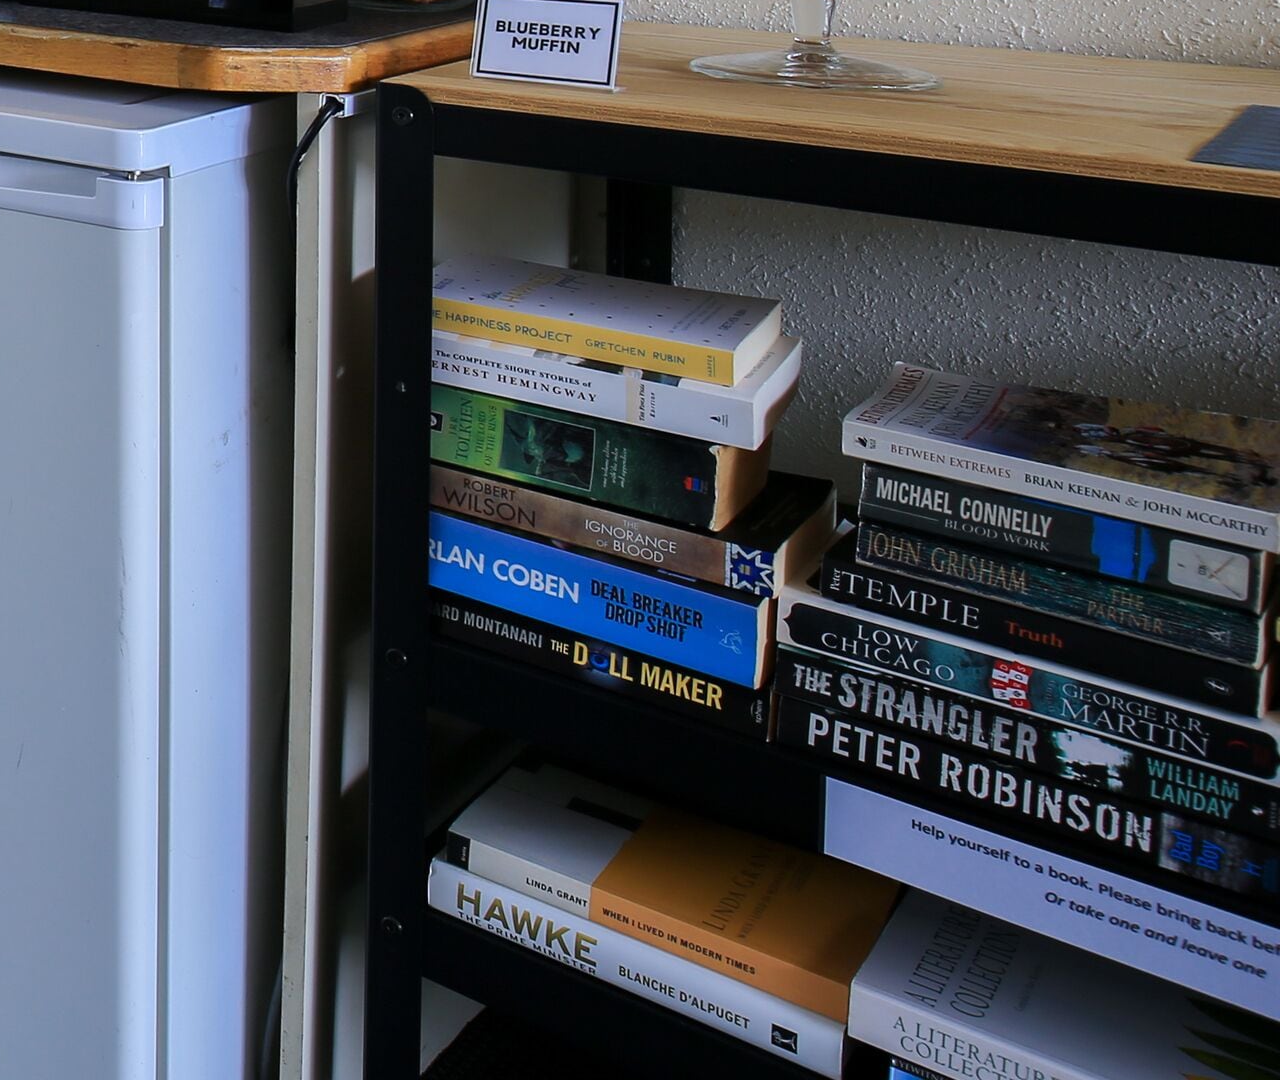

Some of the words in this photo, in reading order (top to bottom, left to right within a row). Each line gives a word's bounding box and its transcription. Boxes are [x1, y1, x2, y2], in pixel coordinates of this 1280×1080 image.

[496, 21, 601, 40] BLUEBERRY
[512, 37, 580, 54] MUFFIN
[445, 310, 511, 333] HAPPINESS
[515, 325, 573, 343] PROJECT
[585, 337, 646, 358] GRETCHEN
[653, 350, 686, 365] RUBIN
[431, 361, 490, 380] ERNEST
[497, 373, 597, 403] HEMINGWAY
[875, 476, 954, 516] MICHAEL
[959, 497, 1054, 539] CONNELLY
[890, 443, 946, 465] BETWEEN
[949, 456, 1011, 479] EXTREMES
[1024, 473, 1064, 490] BRIAN
[1068, 483, 1121, 504] KEENAN
[1125, 497, 1140, 508] &
[1143, 499, 1184, 521] JOHN
[1186, 511, 1269, 538] MCCARTHY
[491, 559, 580, 604] COBEN
[866, 528, 921, 564] JOHN
[930, 546, 1030, 591] GRISHAM
[841, 570, 981, 630] TEMPLE
[464, 611, 542, 648] MONTANARI
[550, 639, 569, 655] THE
[640, 662, 723, 711] MAKER
[793, 663, 833, 696] THE
[837, 672, 1039, 763] STRANGLER
[807, 712, 922, 780] PETER
[939, 753, 1154, 853] ROBINSON
[911, 818, 945, 841] Help
[948, 830, 1010, 863] yourself
[1014, 854, 1031, 869] to
[1034, 863, 1044, 873] a
[1048, 866, 1093, 891] book.
[1098, 884, 1152, 911] Please
[1156, 902, 1202, 930] bring
[1206, 920, 1247, 944] back
[456, 881, 598, 968] HAWKE
[525, 876, 554, 894] LINDA
[556, 889, 588, 908] GRANT
[602, 907, 629, 924] WHEN
[631, 917, 635, 926] I
[637, 920, 665, 938] LIVED
[667, 933, 678, 945] IN
[680, 937, 723, 962] MODERN
[725, 954, 756, 976] TIMES
[618, 965, 676, 999] BLANCHE
[679, 990, 751, 1030] D'ALPUGET
